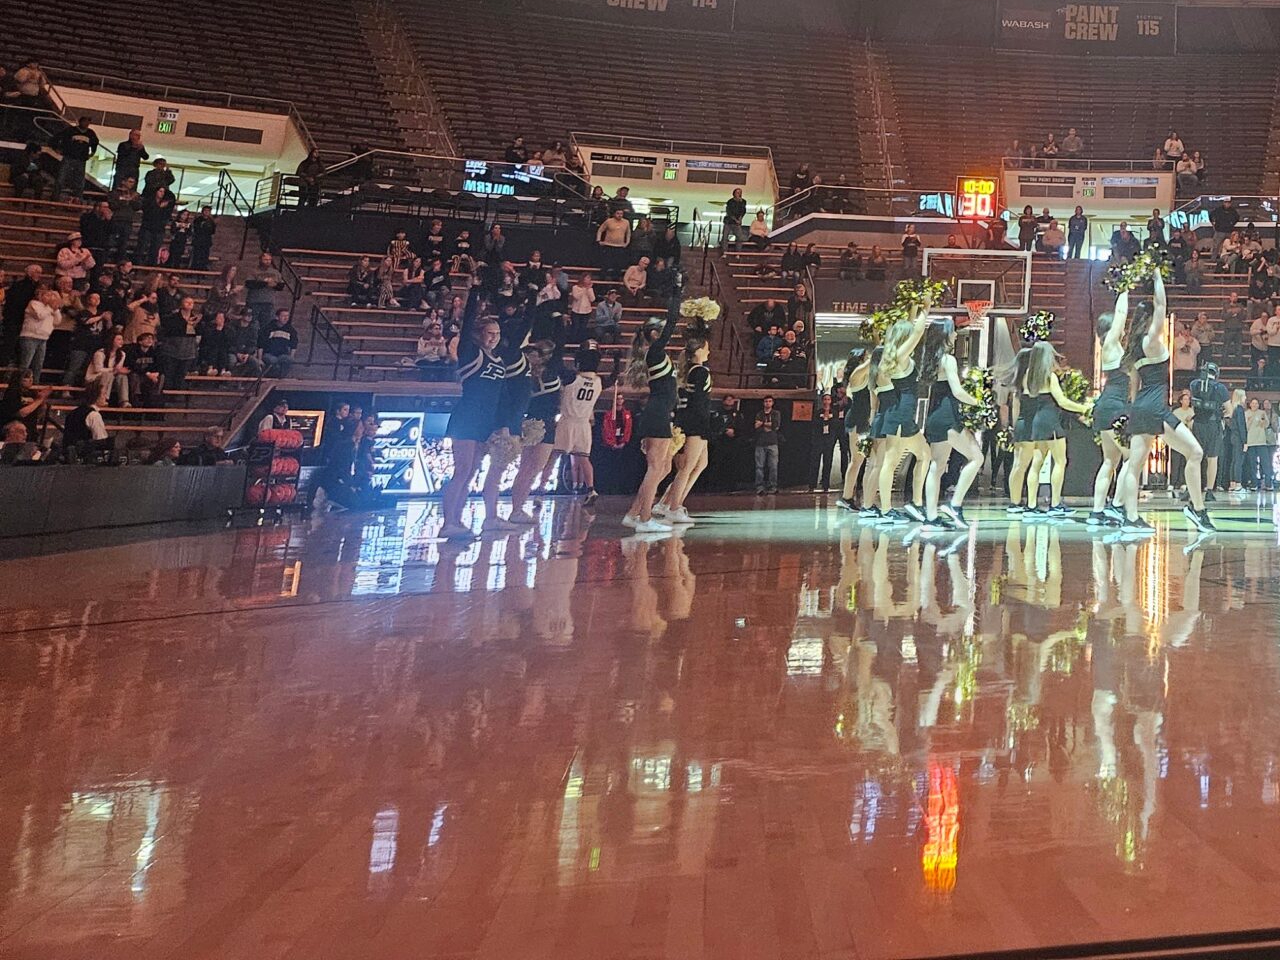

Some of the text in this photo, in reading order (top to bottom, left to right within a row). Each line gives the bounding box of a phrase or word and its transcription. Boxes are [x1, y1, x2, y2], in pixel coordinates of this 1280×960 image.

[1065, 4, 1119, 24] PAINT
[1001, 19, 1050, 29] WABASH
[1064, 22, 1118, 40] CREW
[1137, 20, 1160, 35] 115
[832, 301, 868, 313] TIME
[480, 363, 506, 380] P
[577, 388, 594, 401] 00
[382, 448, 415, 458] 10:00
